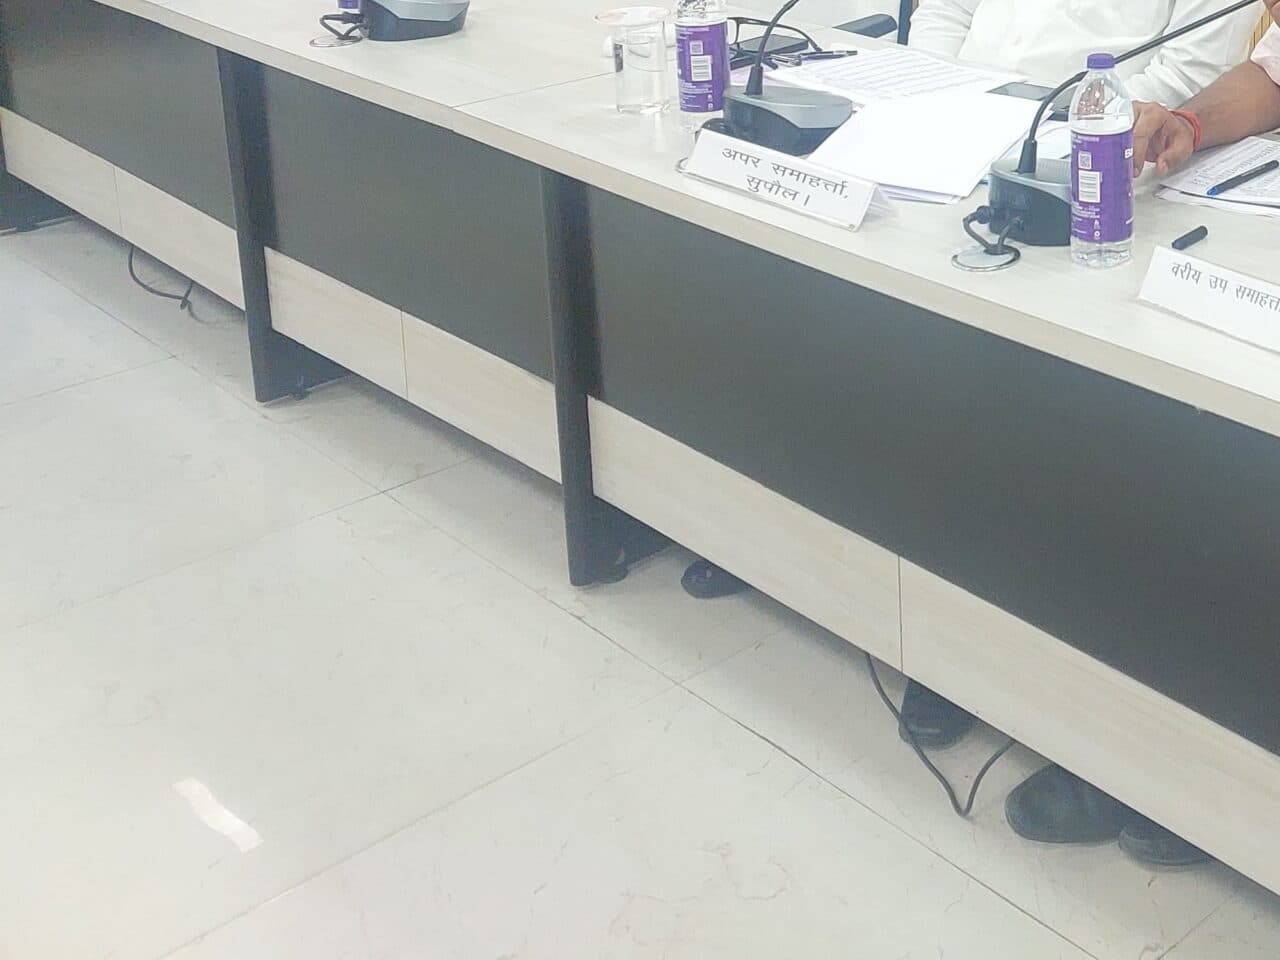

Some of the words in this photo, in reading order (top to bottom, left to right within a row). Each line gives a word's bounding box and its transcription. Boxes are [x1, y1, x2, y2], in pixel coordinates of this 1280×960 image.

[721, 147, 763, 169] अपर
[1171, 262, 1203, 285] वरीय
[1208, 274, 1229, 295] उप
